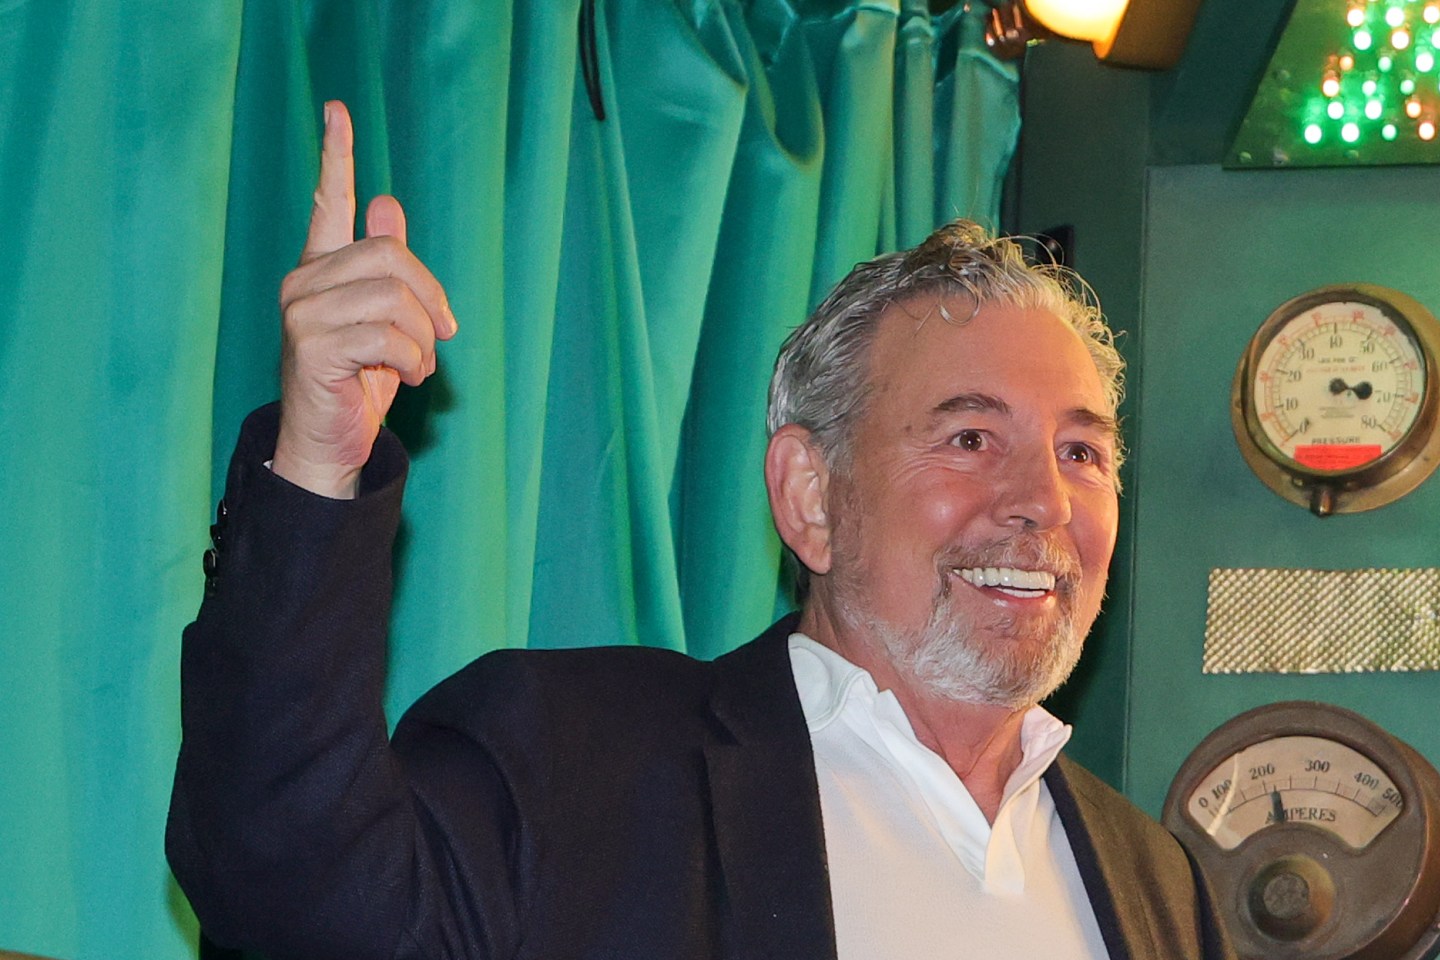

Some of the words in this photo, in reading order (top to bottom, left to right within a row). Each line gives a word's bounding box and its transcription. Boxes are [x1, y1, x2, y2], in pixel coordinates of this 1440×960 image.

[1371, 360, 1388, 372] 60
[1287, 369, 1302, 383] 20
[1374, 390, 1391, 403] 70
[1285, 399, 1298, 411] 10
[1361, 415, 1377, 429] 80
[1249, 763, 1275, 781] 200
[1304, 760, 1331, 773] 300
[1353, 772, 1380, 790] 400
[1211, 778, 1233, 801] 100
[1198, 796, 1208, 809] 0
